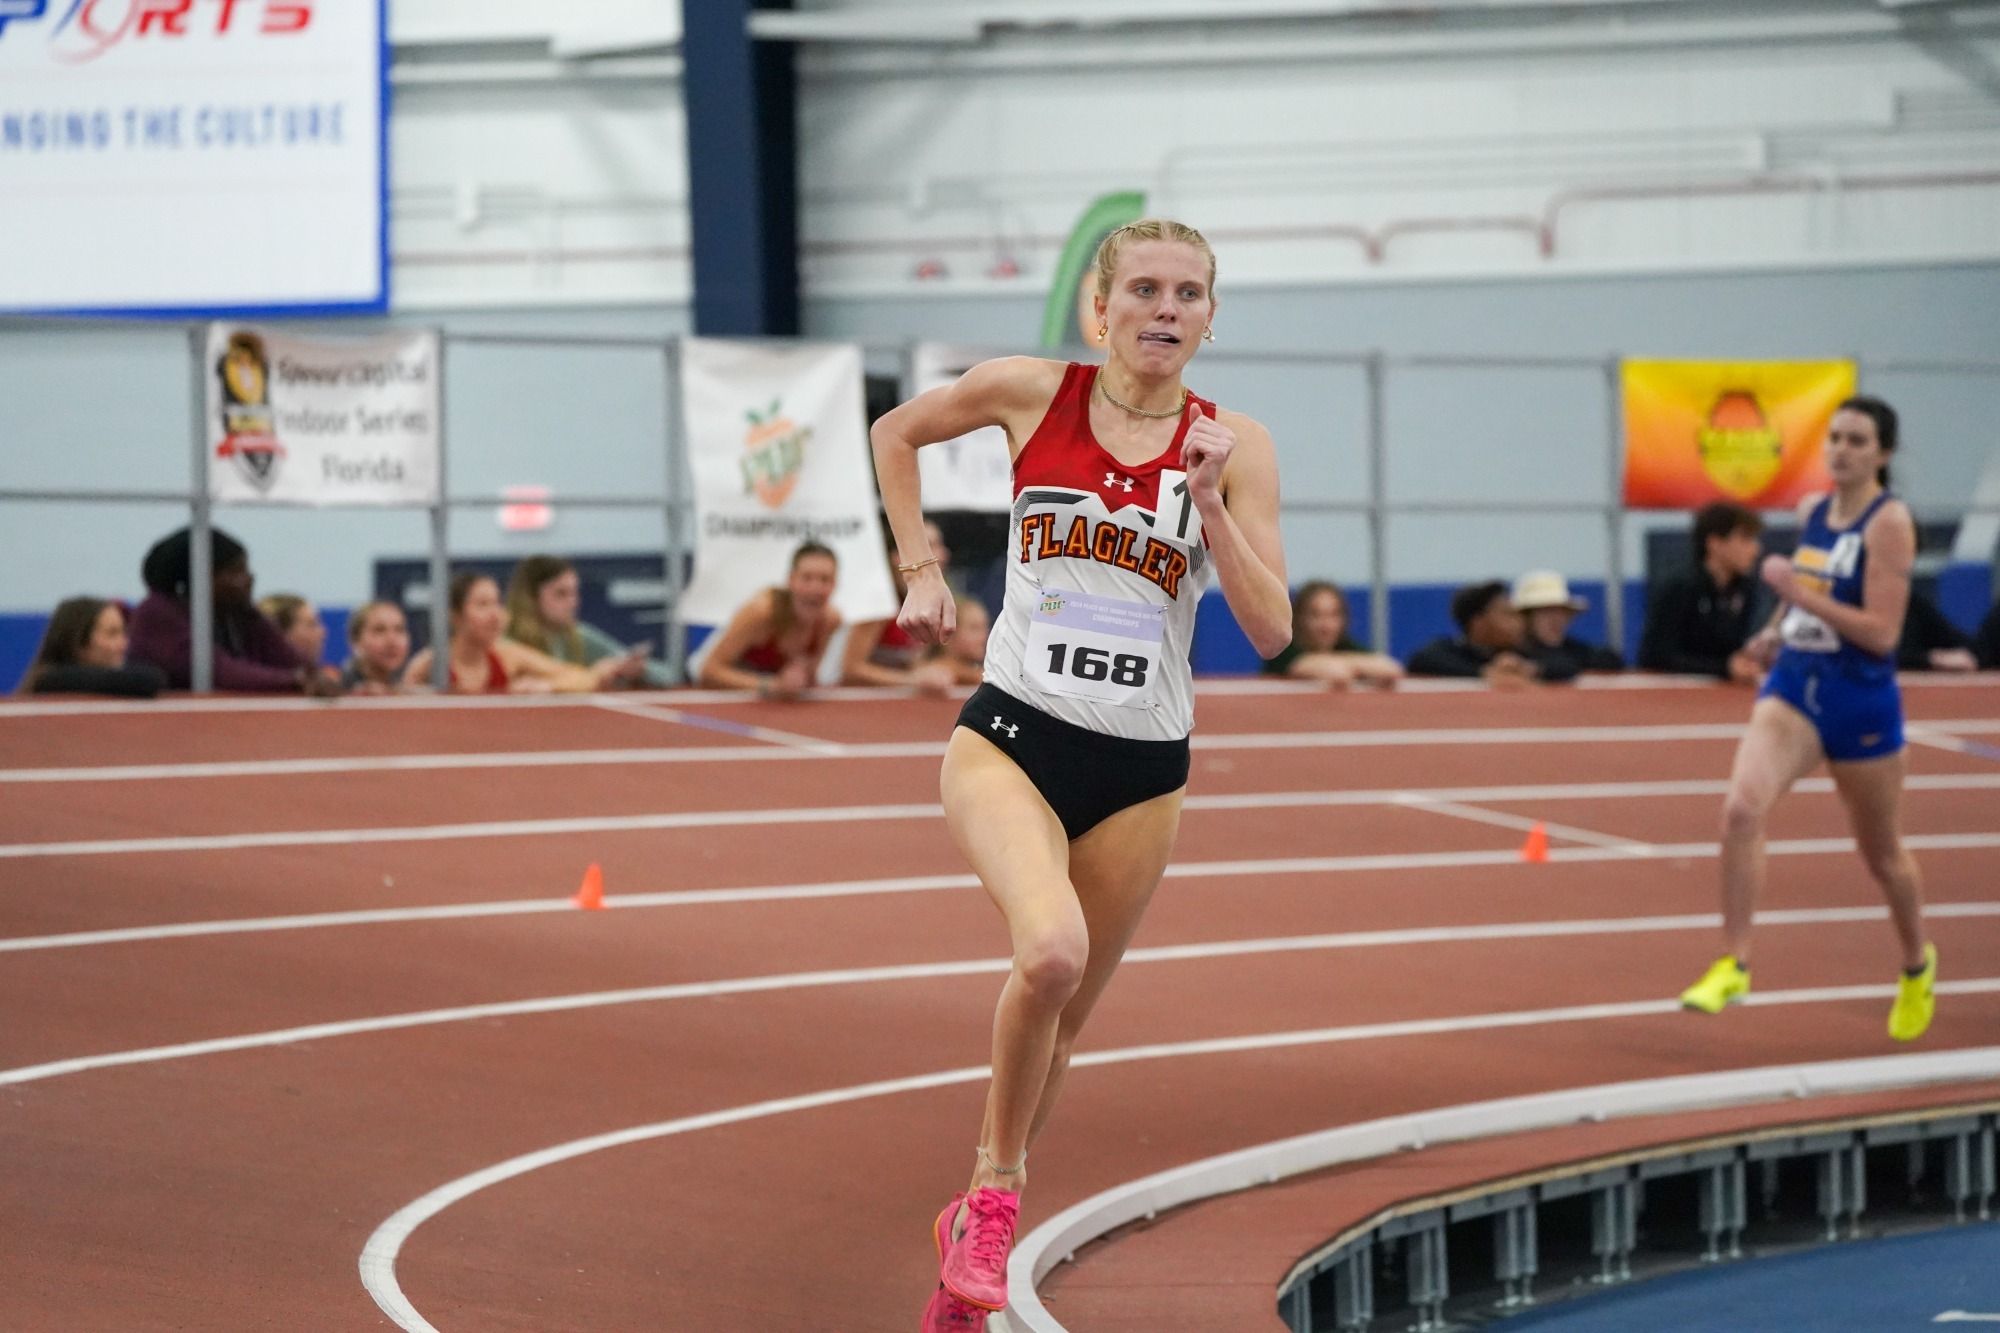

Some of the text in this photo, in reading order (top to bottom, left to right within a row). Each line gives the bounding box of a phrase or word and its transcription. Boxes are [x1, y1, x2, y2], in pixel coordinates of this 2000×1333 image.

[123, 105, 181, 150] THE
[196, 101, 344, 147] CULTURE
[355, 405, 430, 434] Series
[321, 453, 405, 481] Florida
[1172, 479, 1193, 539] 1
[1021, 513, 1187, 601] FLAGLER
[1092, 614, 1140, 628] CHAMPIONSHIPS
[1047, 643, 1149, 687] 168
